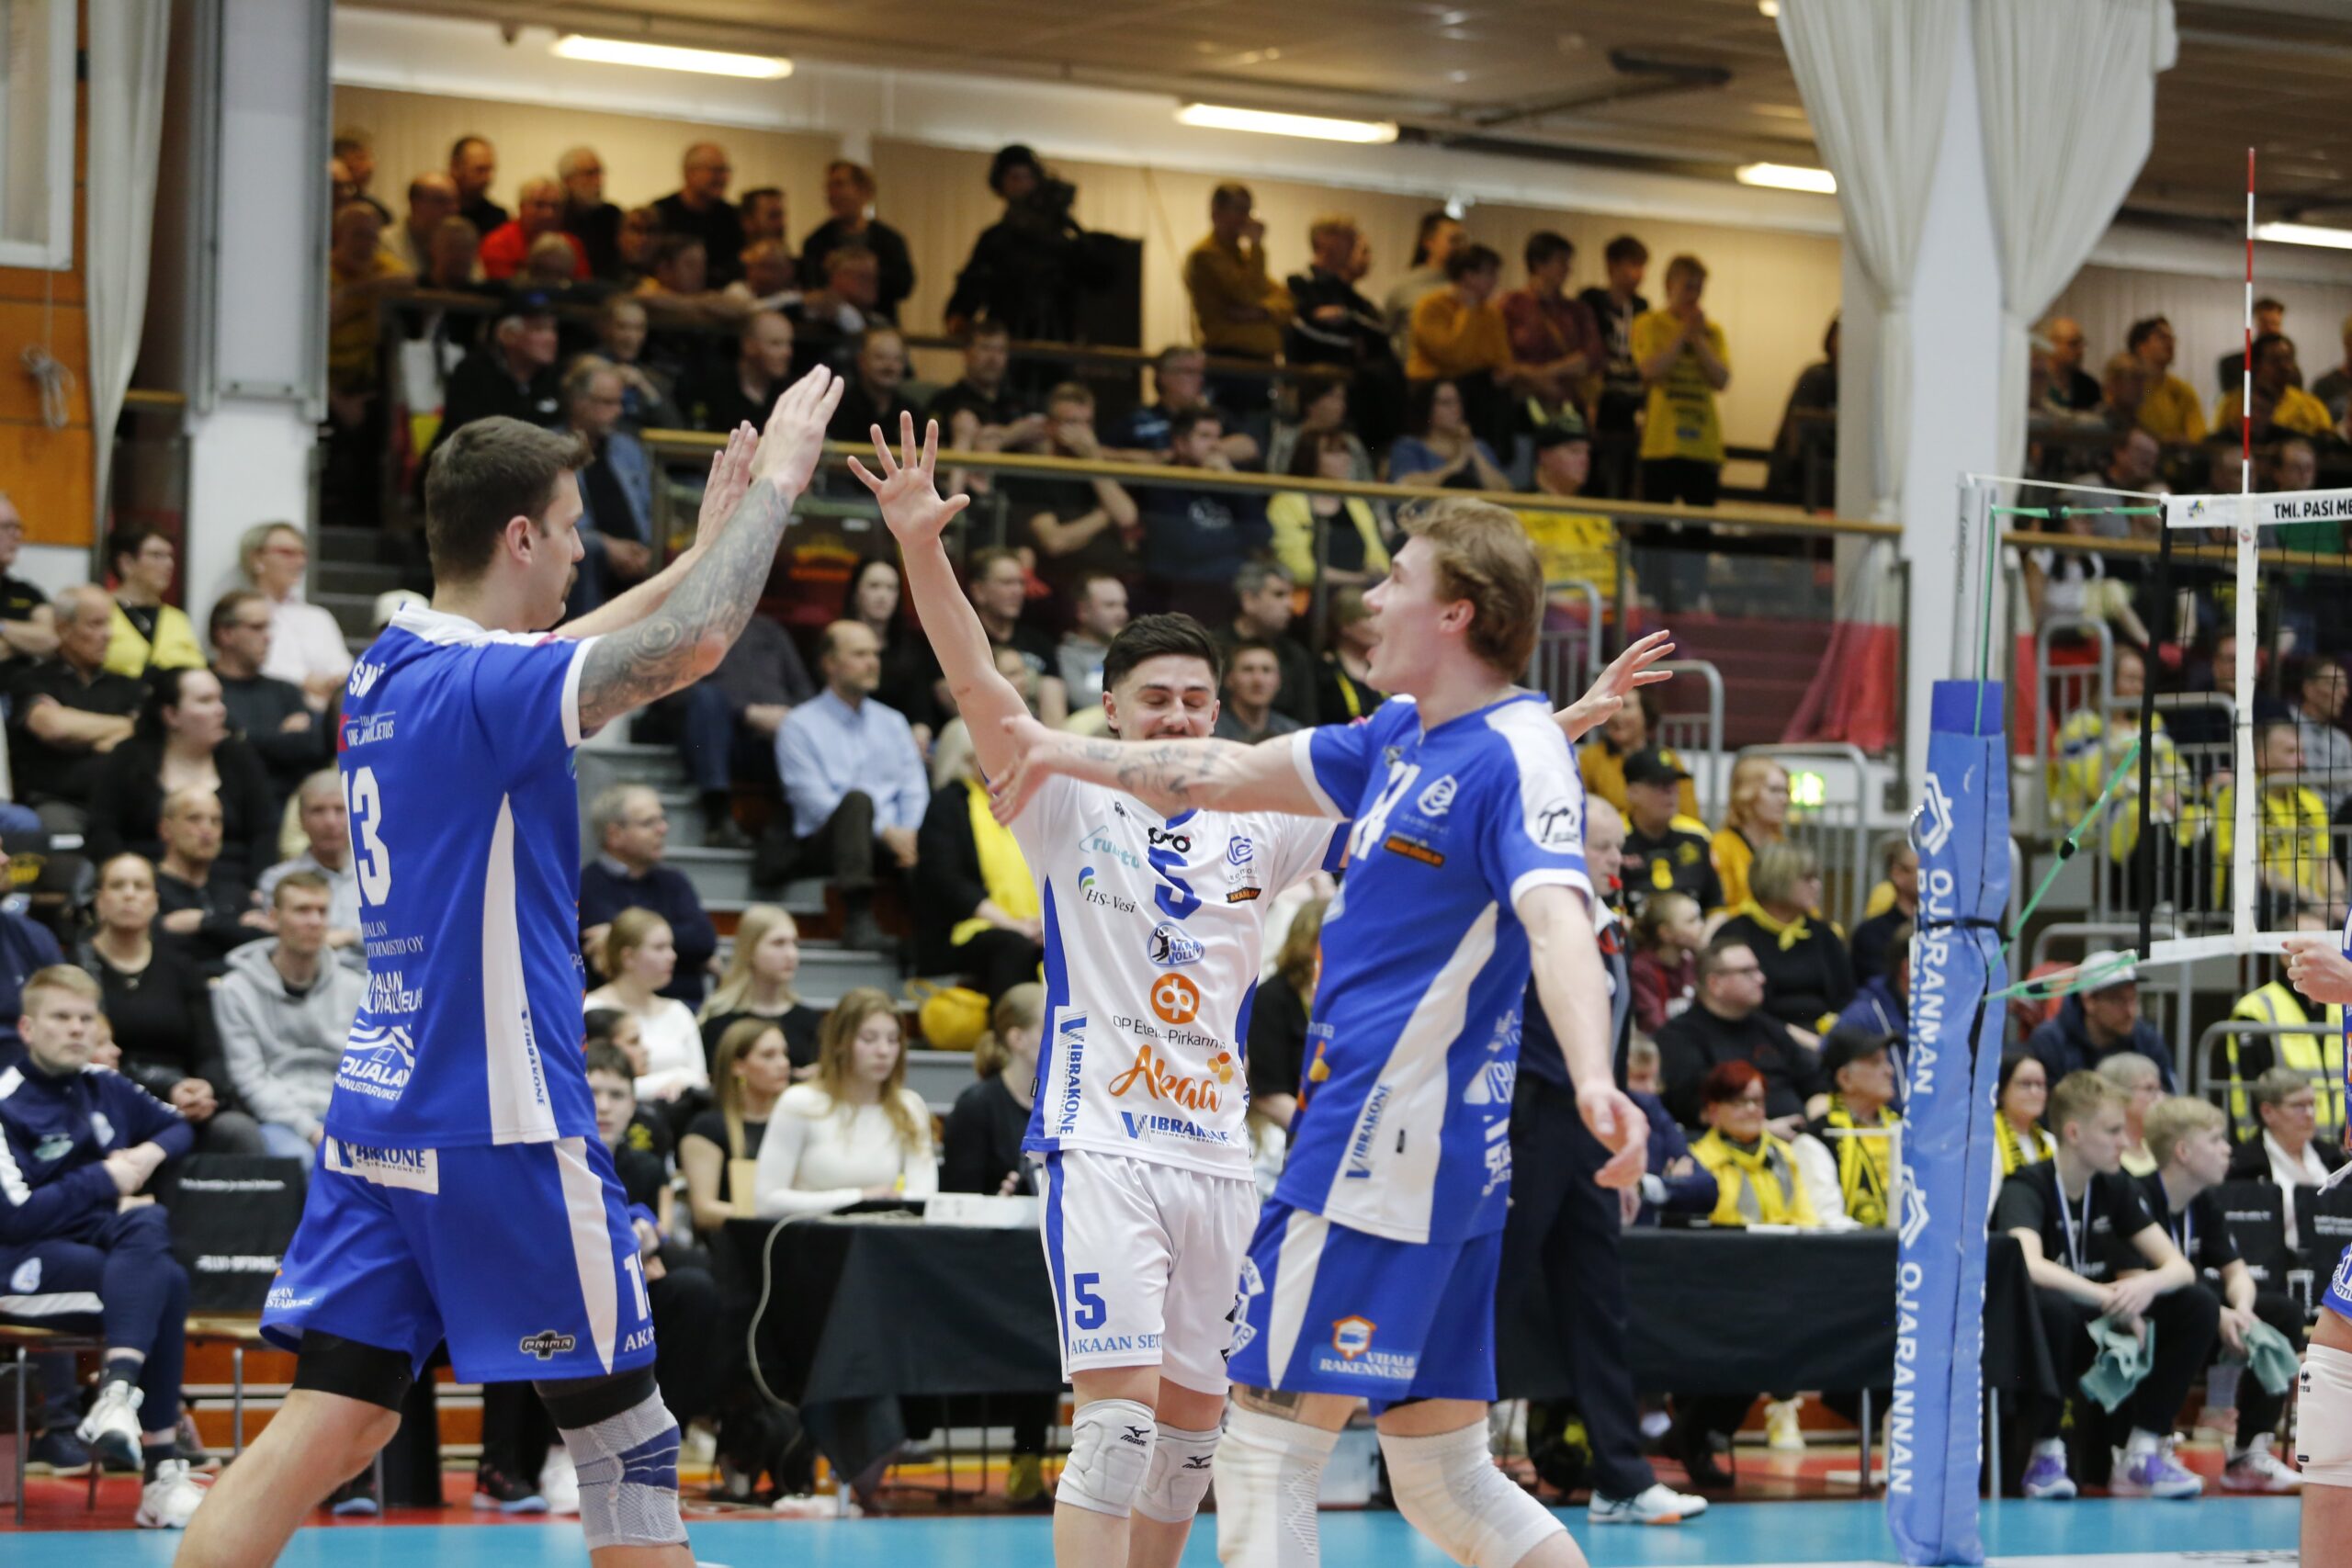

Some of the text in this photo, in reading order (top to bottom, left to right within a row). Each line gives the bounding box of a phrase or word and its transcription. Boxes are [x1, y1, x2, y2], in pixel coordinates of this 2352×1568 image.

[2274, 502, 2301, 519] TMI.
[2303, 500, 2334, 517] PASI
[1086, 888, 1136, 913] HS-Vesi
[1148, 845, 1203, 920] 5
[407, 935, 424, 953] OY
[1059, 1016, 1088, 1135] VIBRAKONE
[624, 1249, 652, 1321] 1
[1073, 1272, 1106, 1330] 5
[1071, 1333, 1162, 1355] AKAAN SEU
[1890, 1262, 1922, 1495] OJARANNAN
